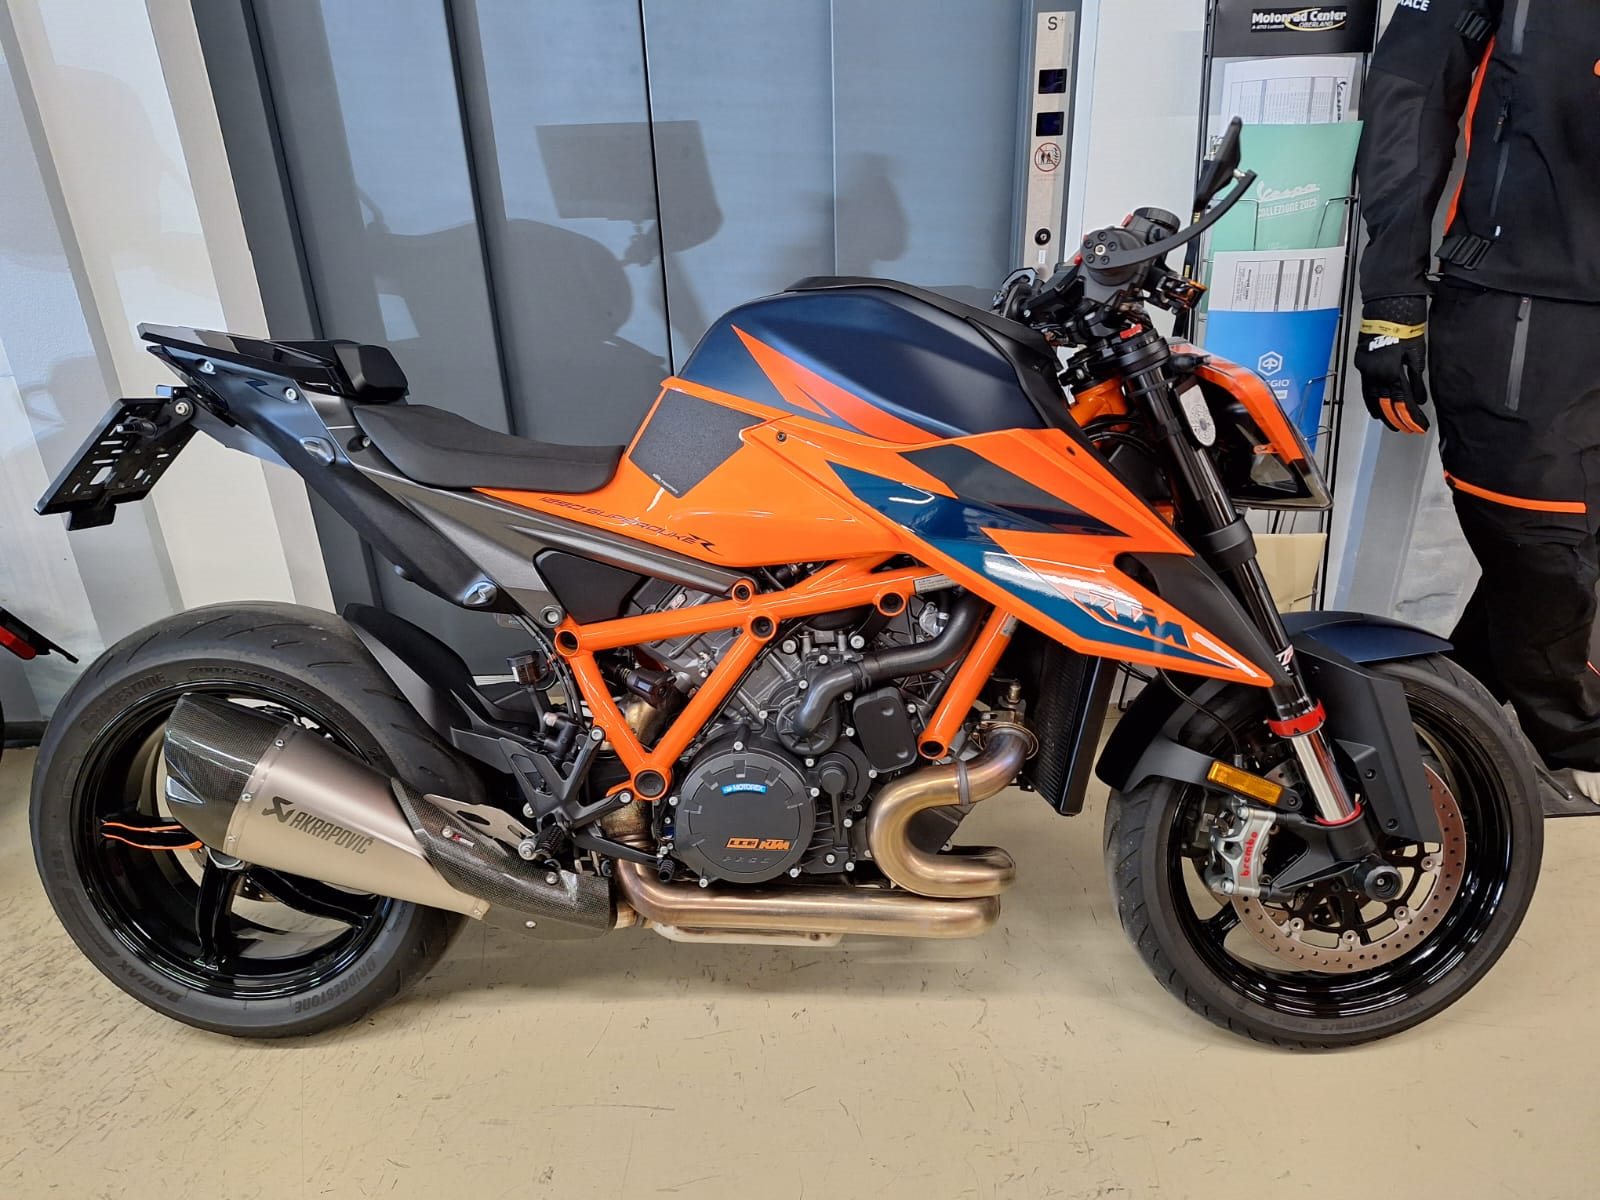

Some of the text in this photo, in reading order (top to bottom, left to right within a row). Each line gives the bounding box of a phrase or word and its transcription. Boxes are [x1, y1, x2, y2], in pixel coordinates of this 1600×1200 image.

[1047, 16, 1058, 31] S
[1251, 10, 1346, 24] Motorrad Center
[1257, 181, 1320, 203] Vespa
[1074, 591, 1189, 648] KTM
[759, 838, 791, 850] KTM
[1240, 831, 1258, 877] brembo
